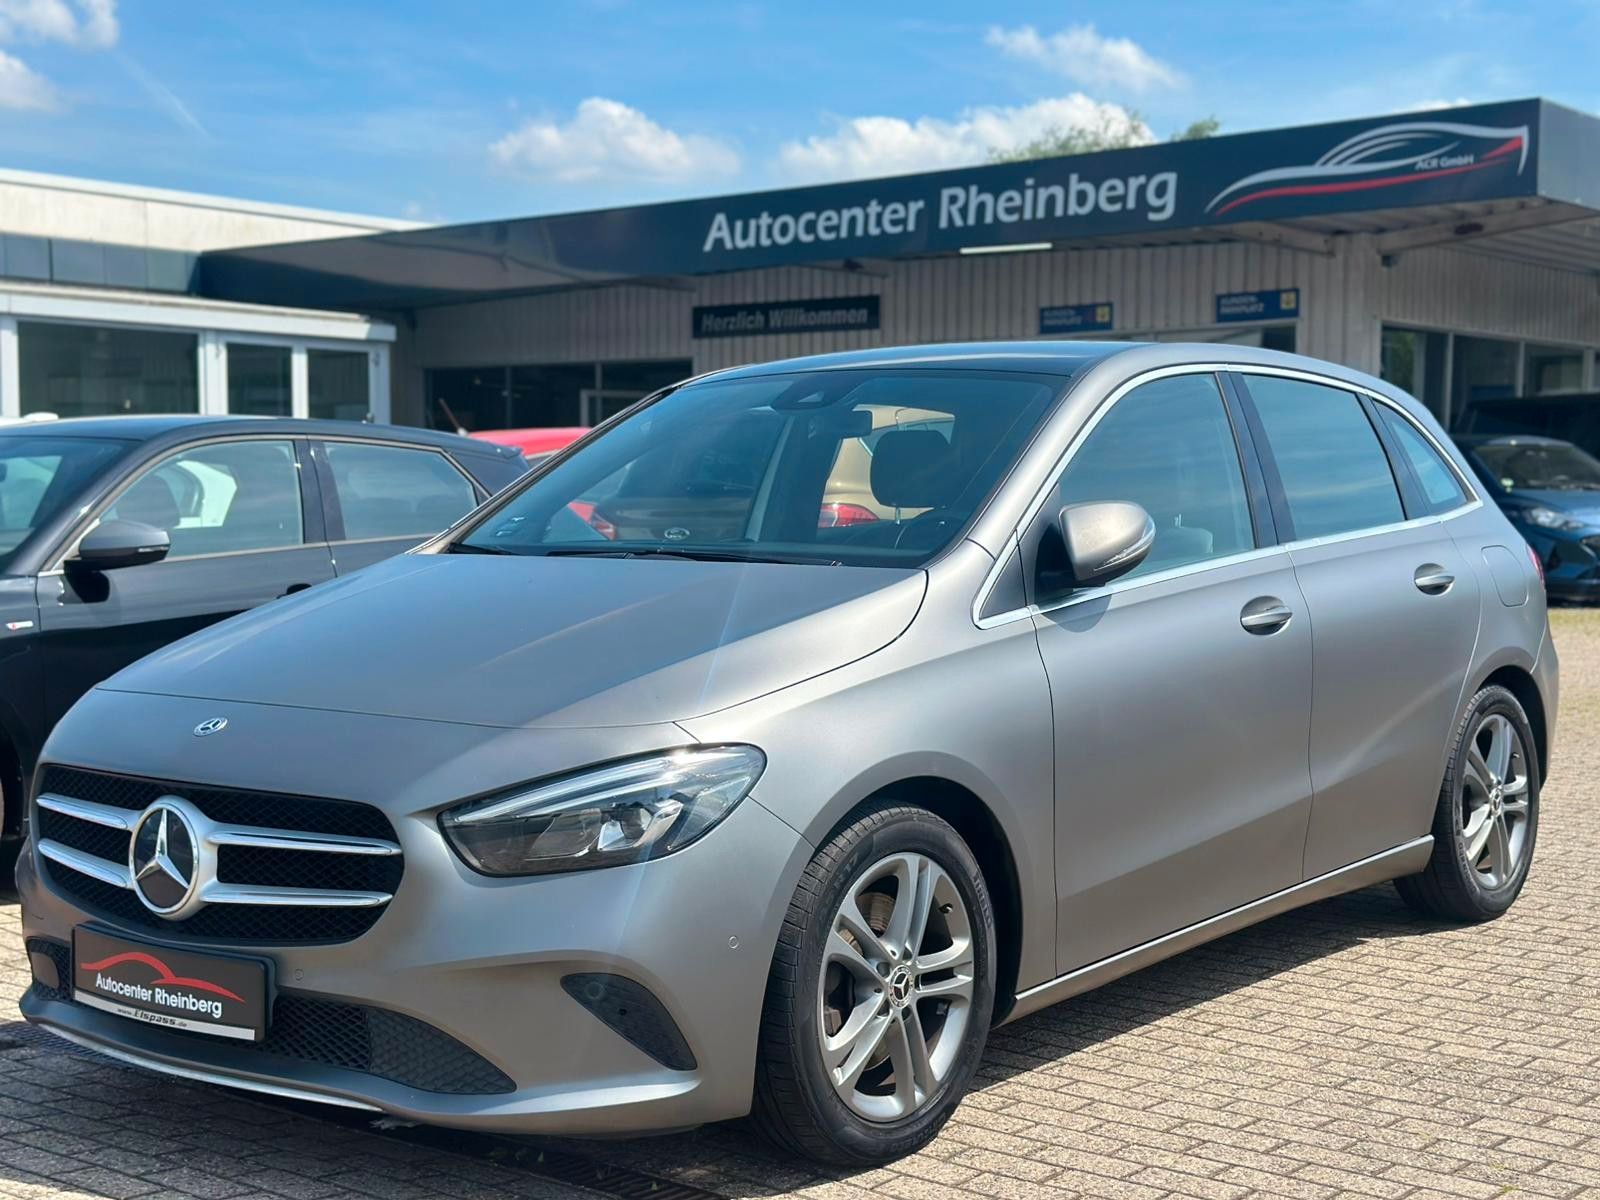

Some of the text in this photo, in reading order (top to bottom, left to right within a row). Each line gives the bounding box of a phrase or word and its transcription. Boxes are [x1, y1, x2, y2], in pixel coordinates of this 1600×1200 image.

[703, 171, 1178, 252] Autocenter Rheinberg
[701, 307, 868, 333] Herzlich Willkommen
[96, 972, 222, 1018] Autocenter Rheinberg
